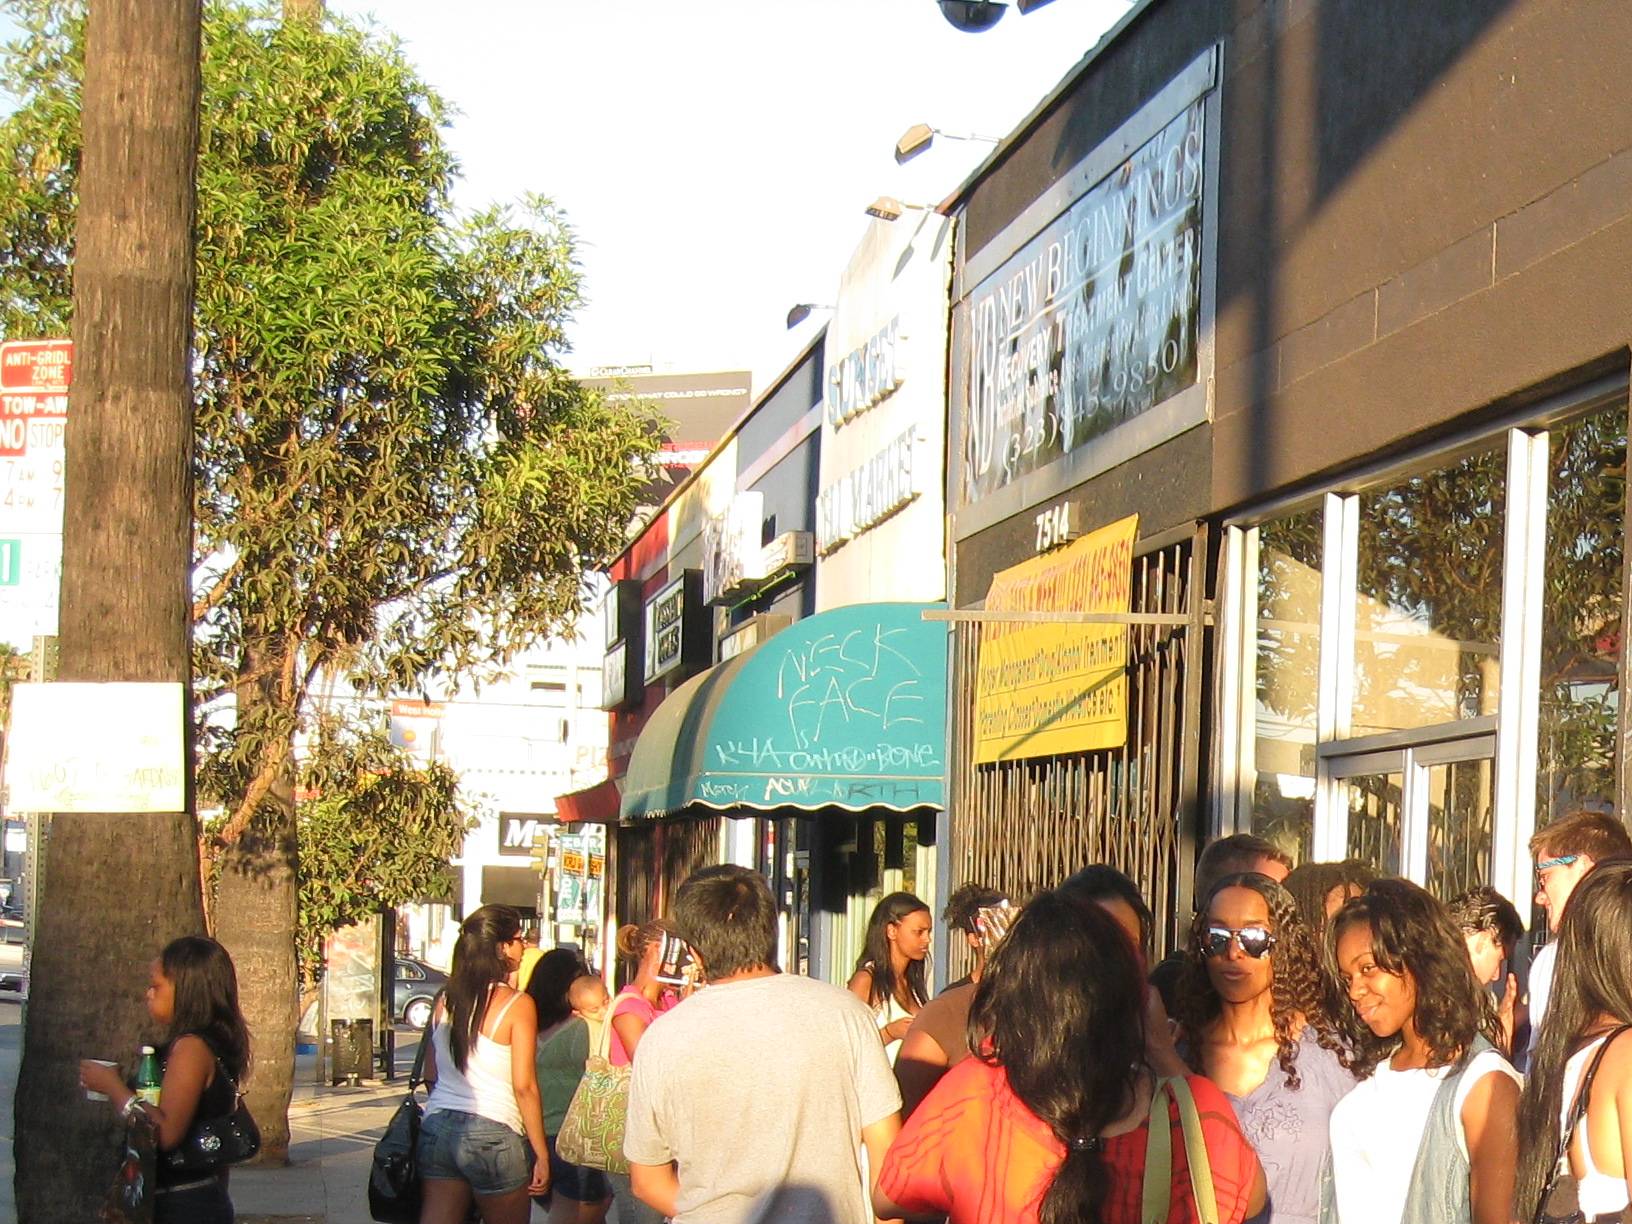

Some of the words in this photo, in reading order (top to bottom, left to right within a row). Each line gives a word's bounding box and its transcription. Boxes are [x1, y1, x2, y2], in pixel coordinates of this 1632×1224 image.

[999, 256, 1043, 336] NEW
[1046, 130, 1199, 302] BEGINNINGS
[998, 327, 1052, 391] RECOVERY
[1136, 227, 1193, 294] CENTER
[32, 365, 65, 380] ZONE
[0, 418, 25, 450] NO
[1035, 502, 1070, 551] 7514
[778, 623, 922, 699] NECK
[788, 675, 924, 750] FACE
